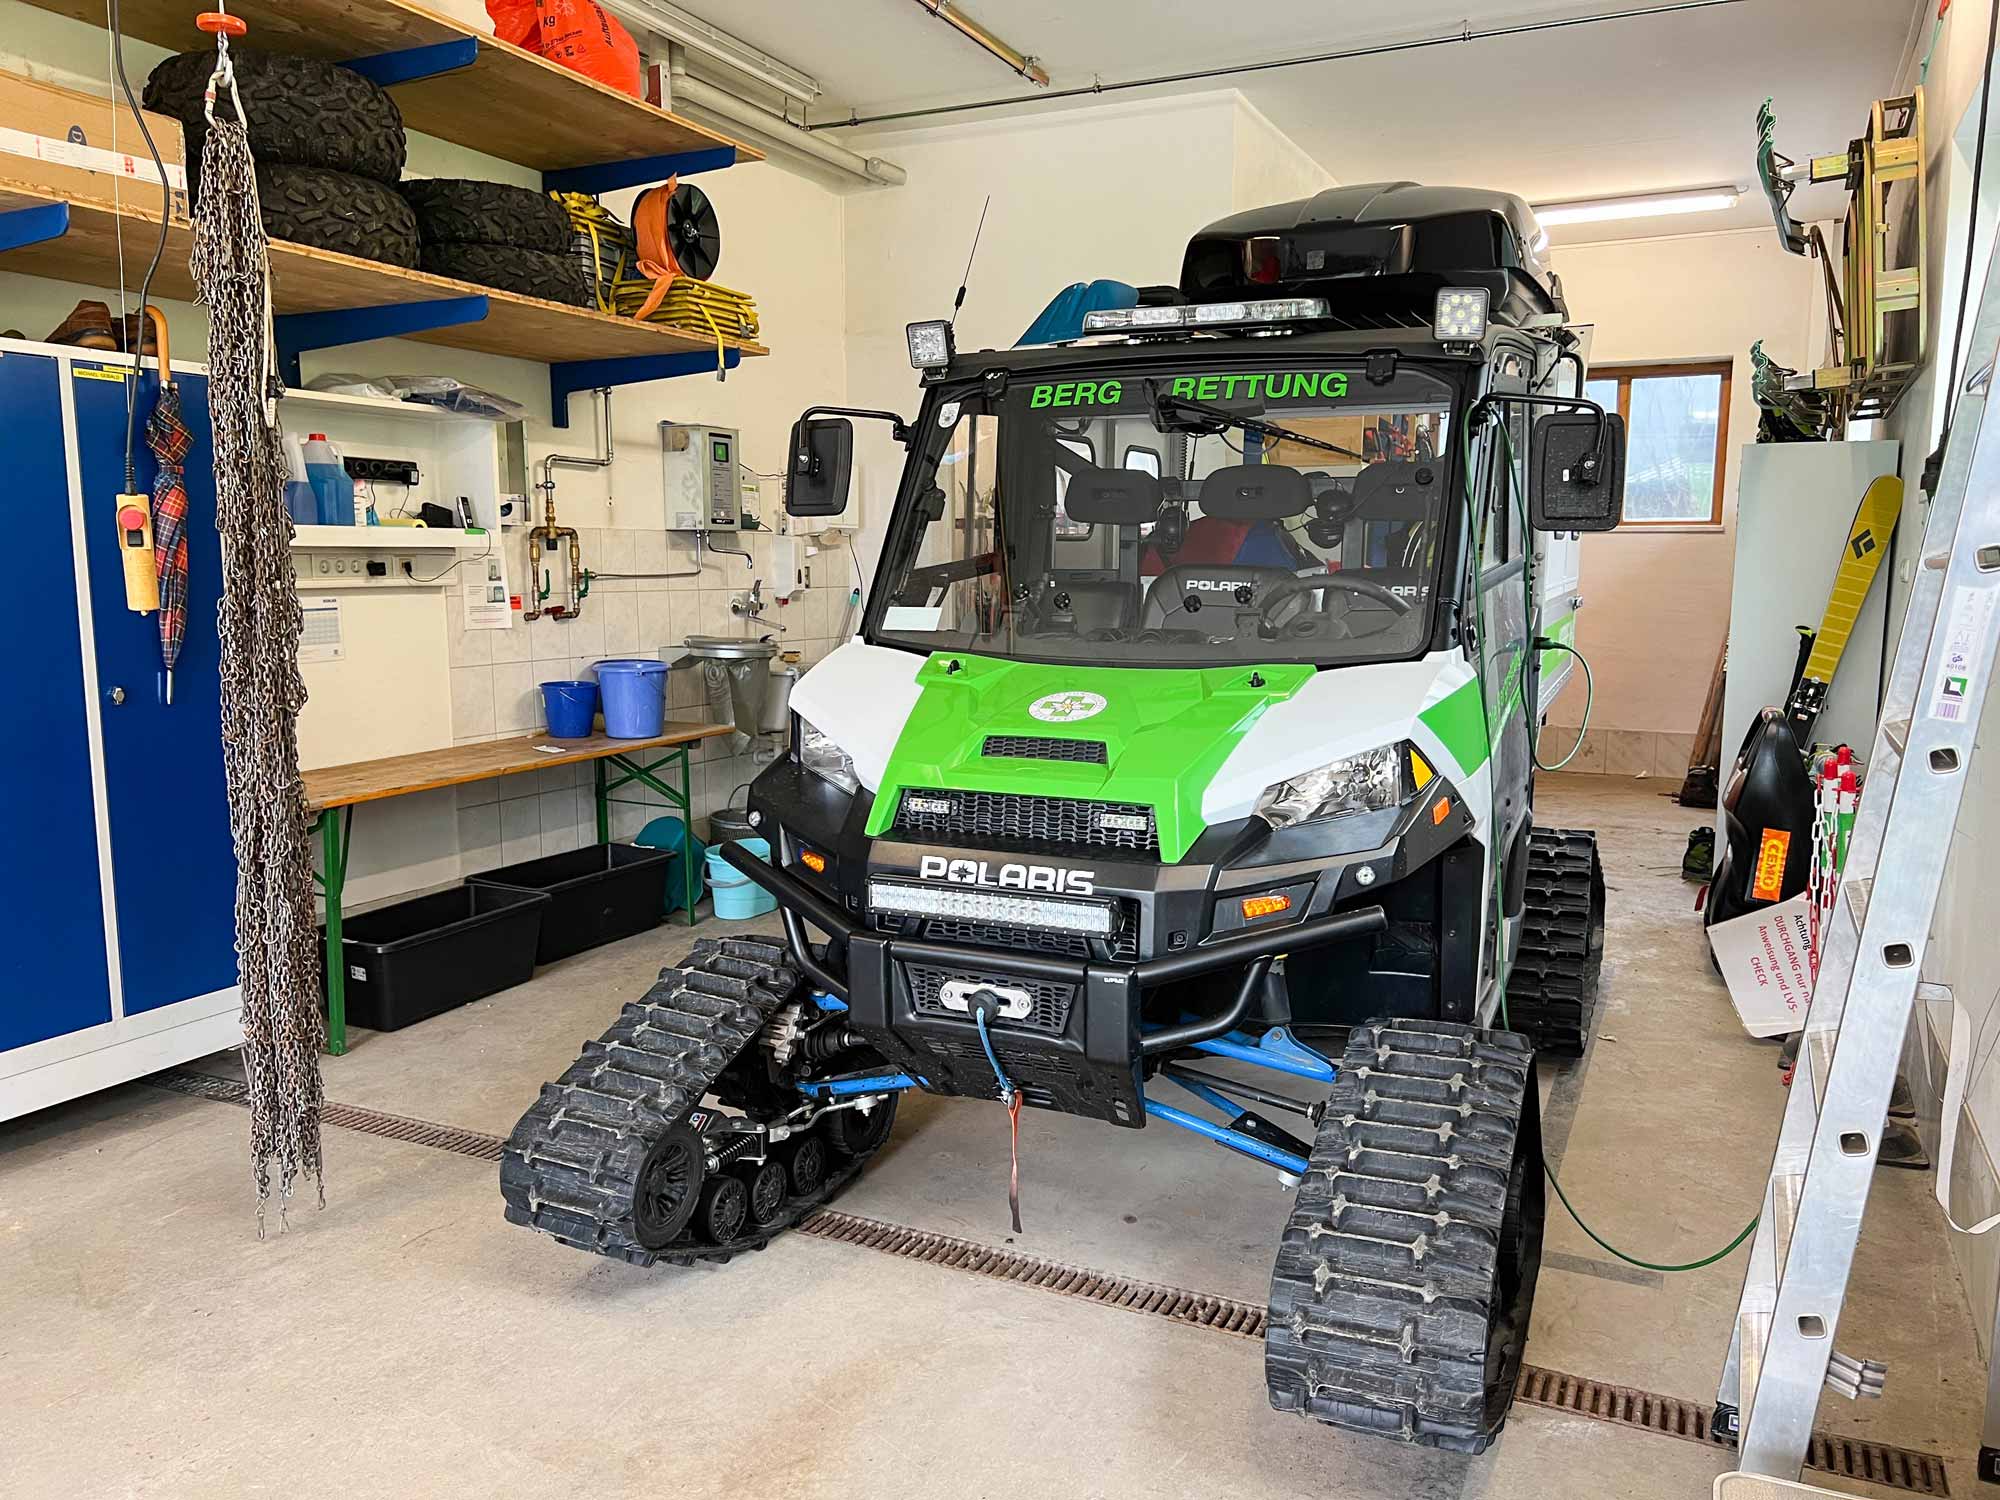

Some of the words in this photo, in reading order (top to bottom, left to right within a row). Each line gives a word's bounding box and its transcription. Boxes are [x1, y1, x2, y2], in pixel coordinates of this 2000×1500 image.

[1030, 381, 1122, 408] BERG
[1171, 372, 1349, 400] RETTUNG
[1186, 580, 1252, 592] POLAR
[919, 855, 1095, 896] POLARIS
[1761, 842, 1781, 889] CEMO
[1794, 914, 1812, 951] Achtung
[1750, 956, 1769, 987] CHECK
[1758, 925, 1781, 972] Anweisung
[1775, 973, 1790, 992] und
[1783, 990, 1799, 1014] LVS-
[1774, 915, 1800, 971] DURCHGANG
[1795, 971, 1808, 990] nur
